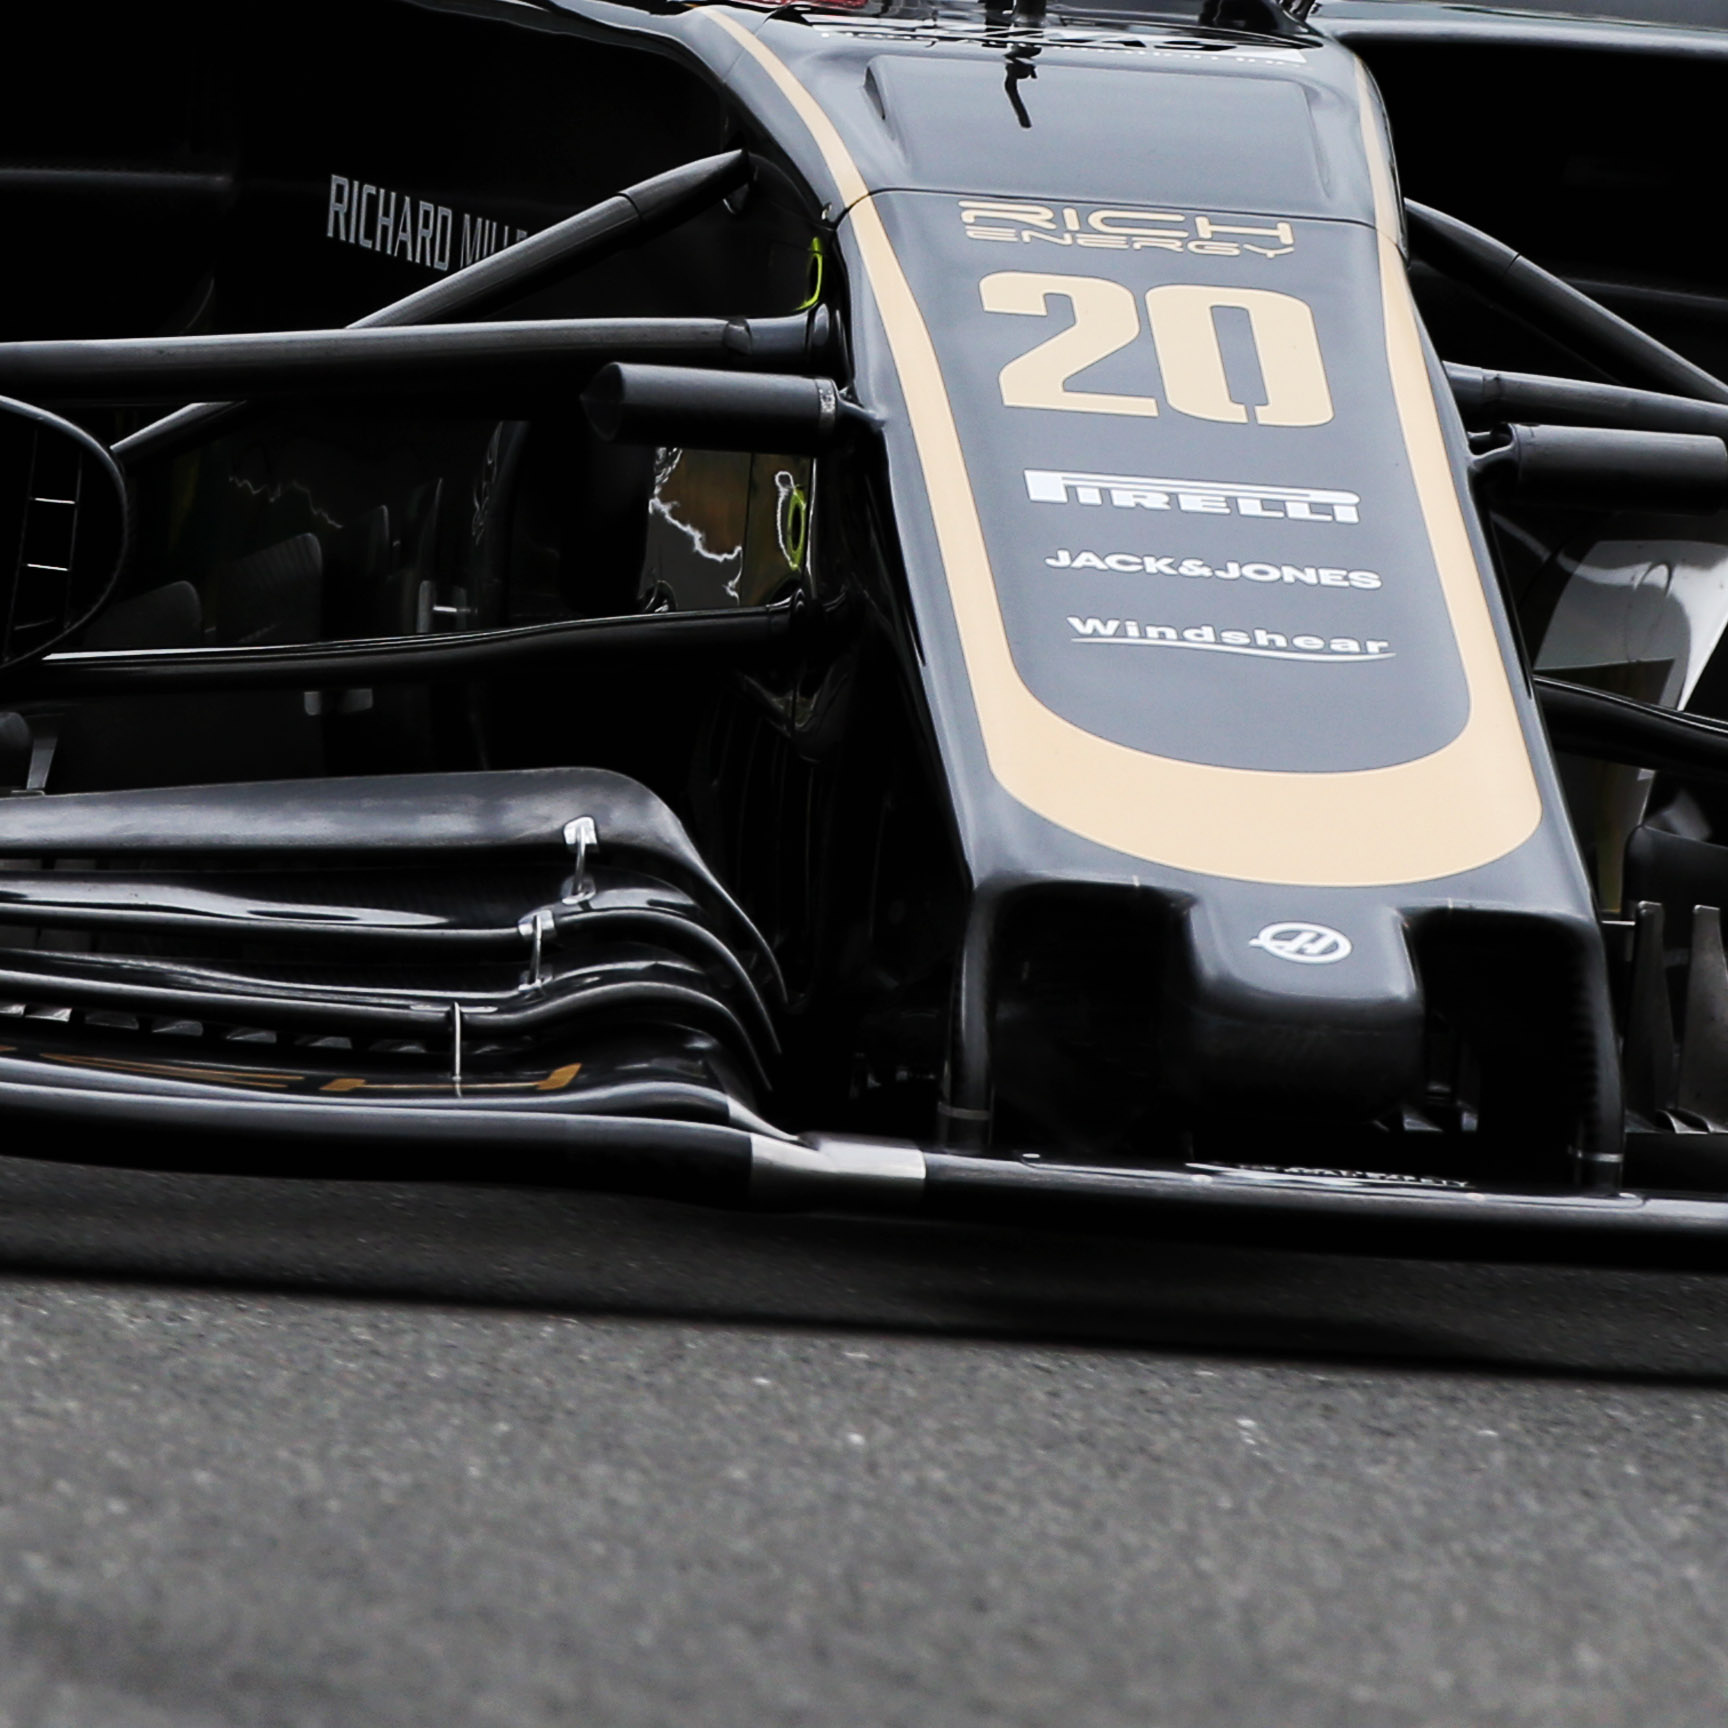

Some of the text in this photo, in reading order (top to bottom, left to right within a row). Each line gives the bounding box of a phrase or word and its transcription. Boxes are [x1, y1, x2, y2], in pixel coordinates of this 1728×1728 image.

[327, 173, 453, 272] RICHARD
[958, 200, 1295, 246] RICH
[964, 225, 1296, 260] ENERGY
[978, 270, 1335, 428] 20
[1023, 469, 1361, 524] PIRELLI
[1044, 548, 1383, 590] JACK&JONES
[1066, 615, 1390, 655] Windshear
